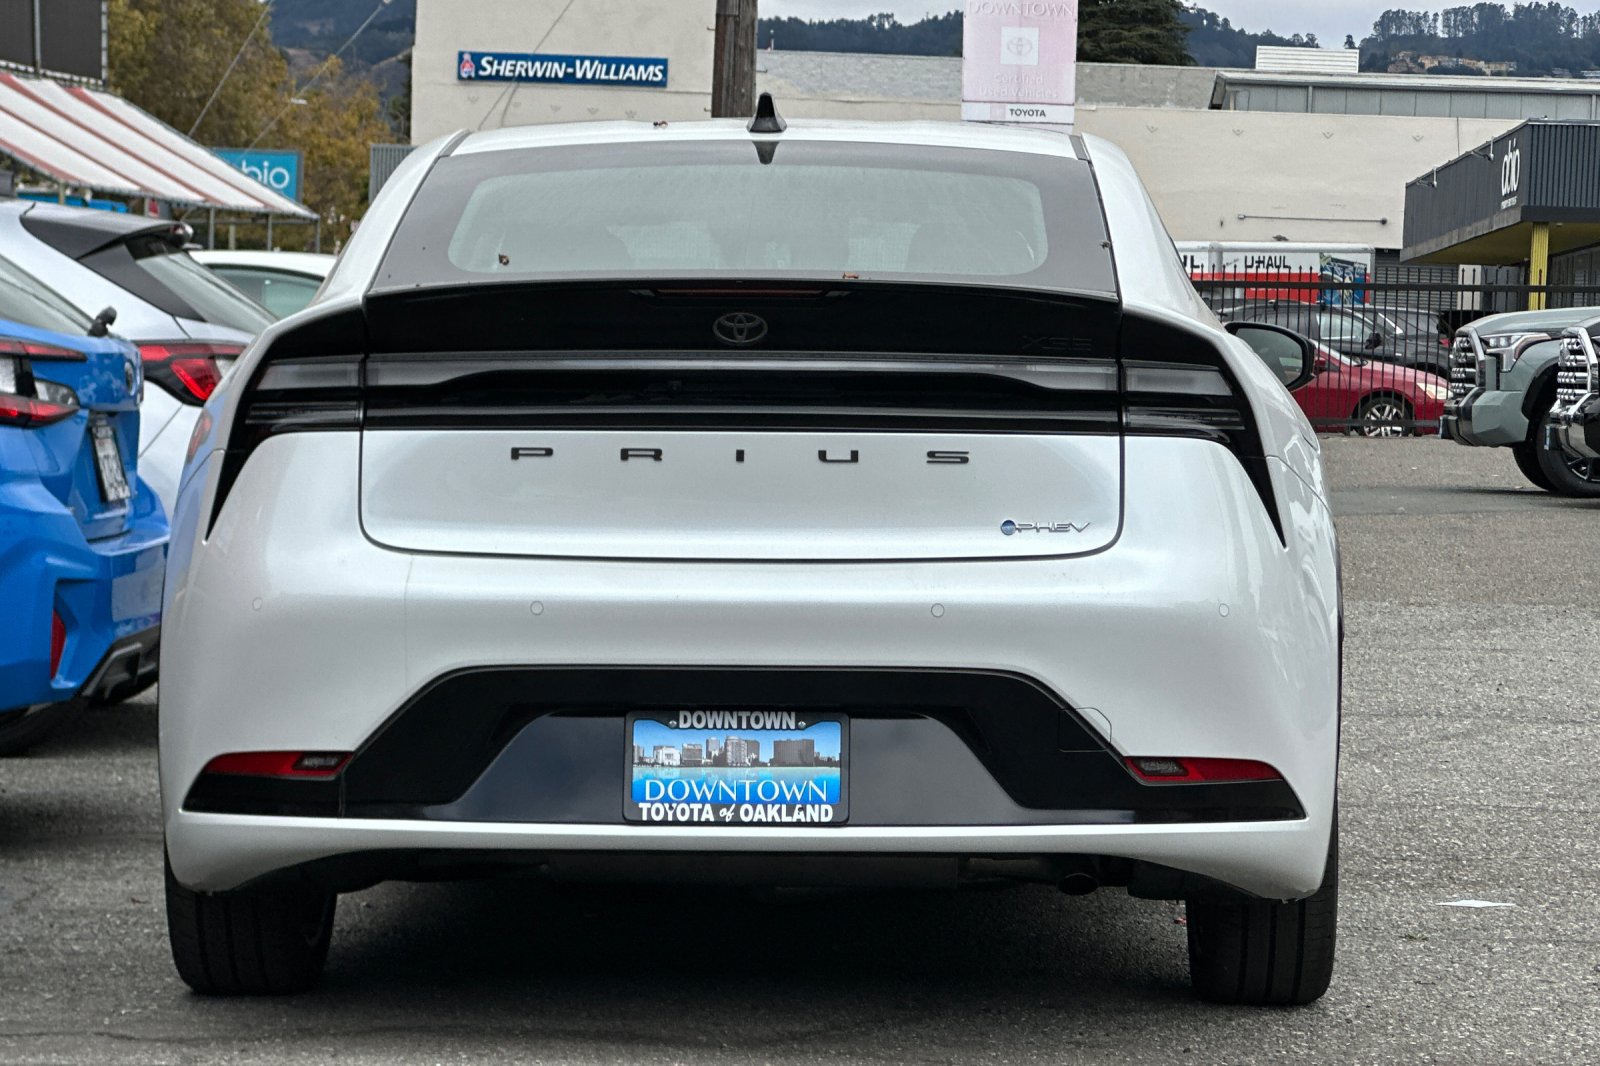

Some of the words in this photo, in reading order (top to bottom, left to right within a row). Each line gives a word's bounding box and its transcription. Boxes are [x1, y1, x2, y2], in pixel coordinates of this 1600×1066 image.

[968, 1, 1075, 17] DOWNTOWN
[478, 56, 664, 82] SHERWIN-WILLIAMS
[1009, 108, 1046, 117] TOYOTA
[1244, 255, 1290, 270] U-HAUL
[1021, 335, 1093, 351] XSE
[511, 447, 969, 464] PRIUS
[1015, 522, 1090, 533] PHEV
[678, 710, 796, 730] DOWNTOWN
[645, 779, 827, 802] DOWNTOWN
[638, 803, 715, 821] TOYOTA
[719, 804, 736, 823] of
[739, 804, 833, 823] OAKLAND
